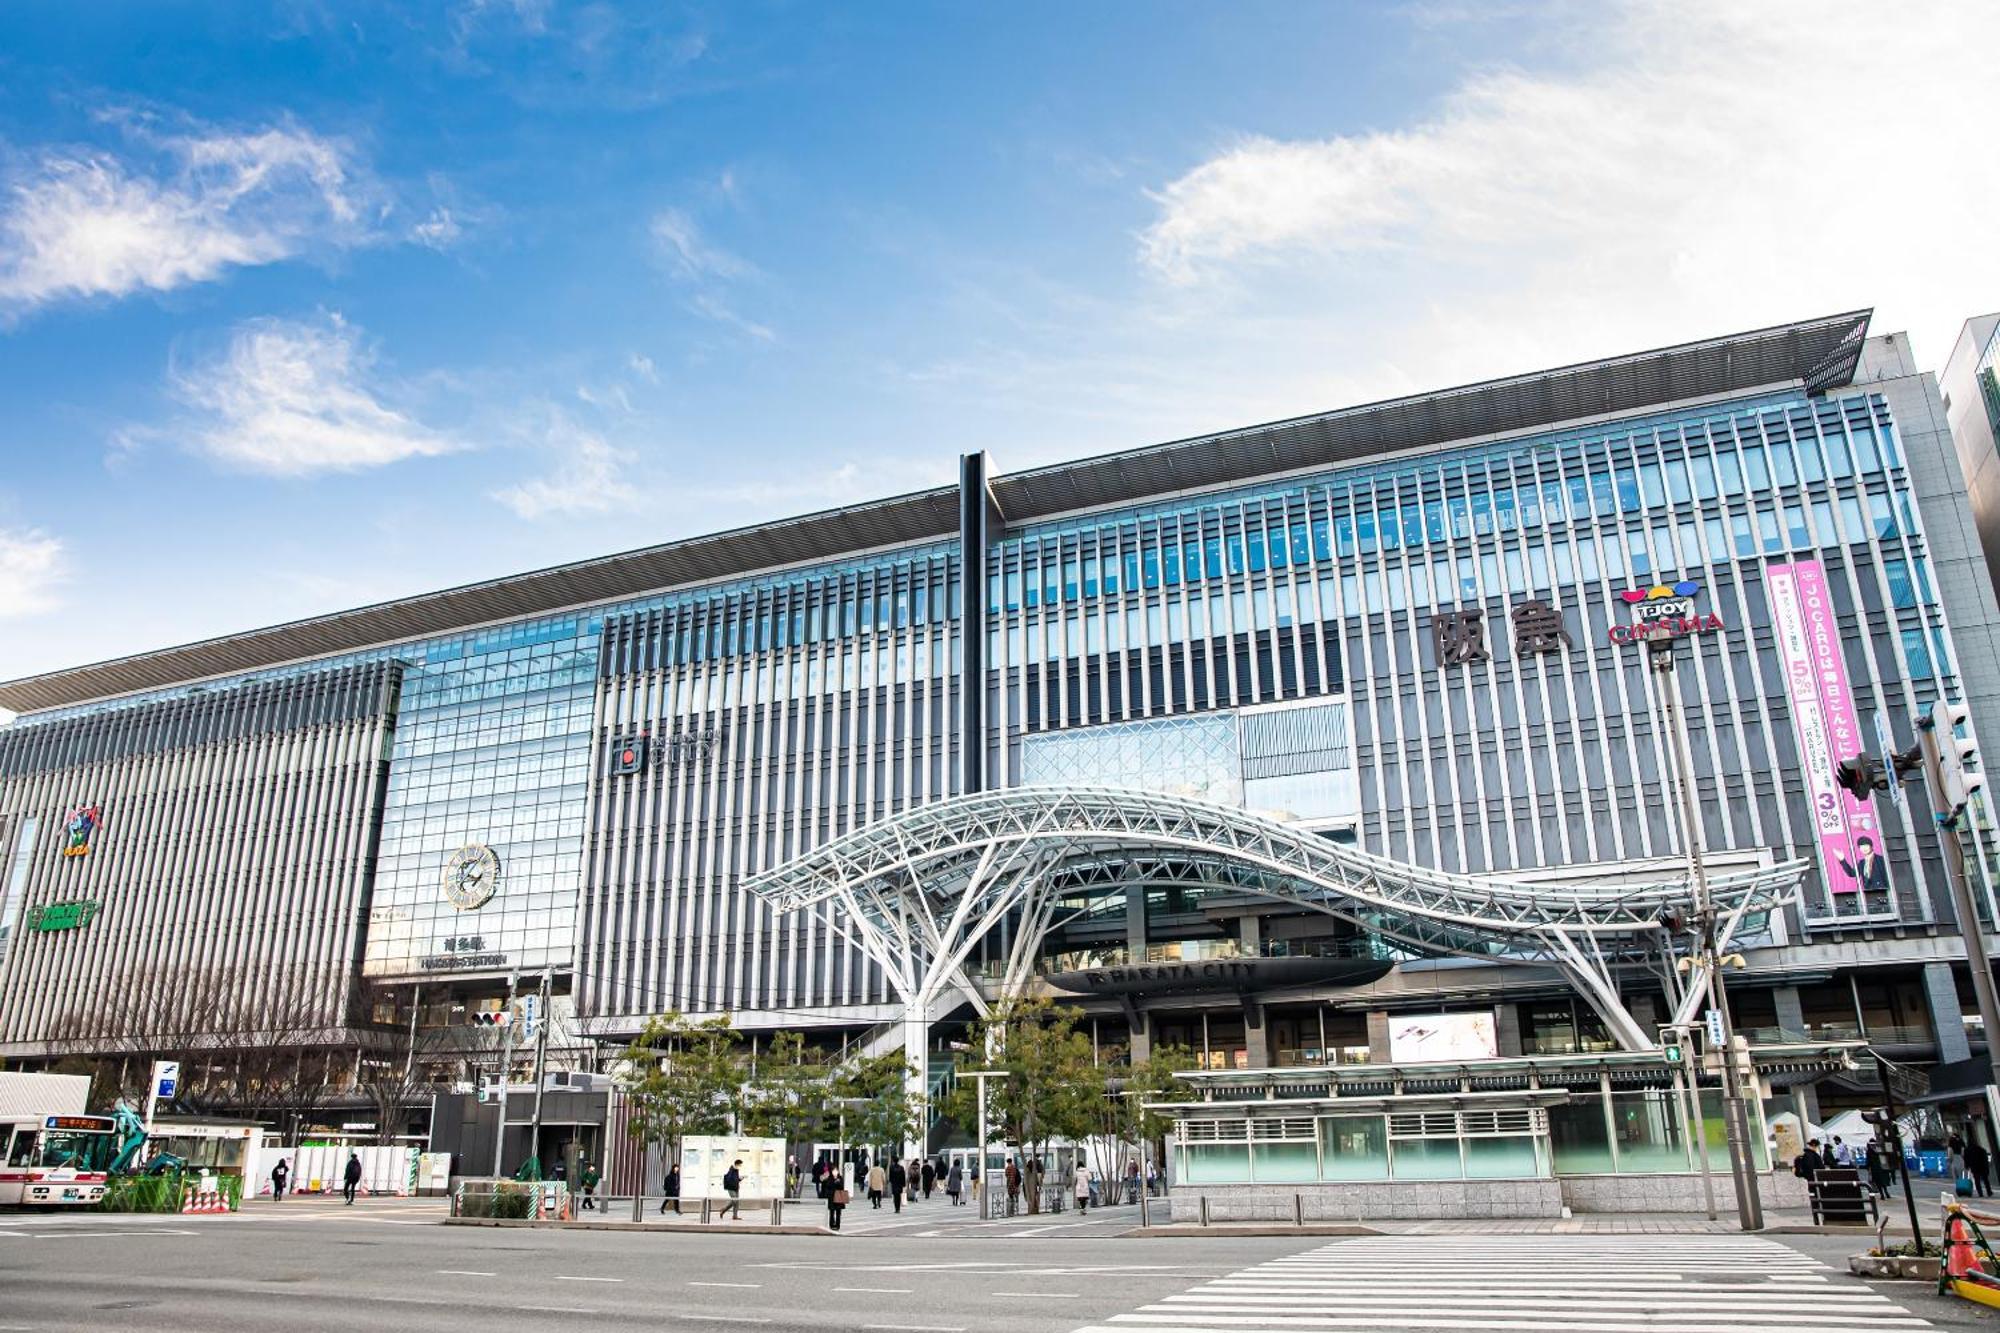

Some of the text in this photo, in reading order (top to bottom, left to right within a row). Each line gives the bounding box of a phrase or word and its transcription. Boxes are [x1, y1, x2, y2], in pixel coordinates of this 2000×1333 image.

[1431, 599, 1572, 666] 阪急
[1608, 612, 1725, 644] CINEMA
[444, 936, 486, 951] 博多駅
[1109, 965, 1193, 983] HAKATA
[1203, 963, 1258, 981] CITY
